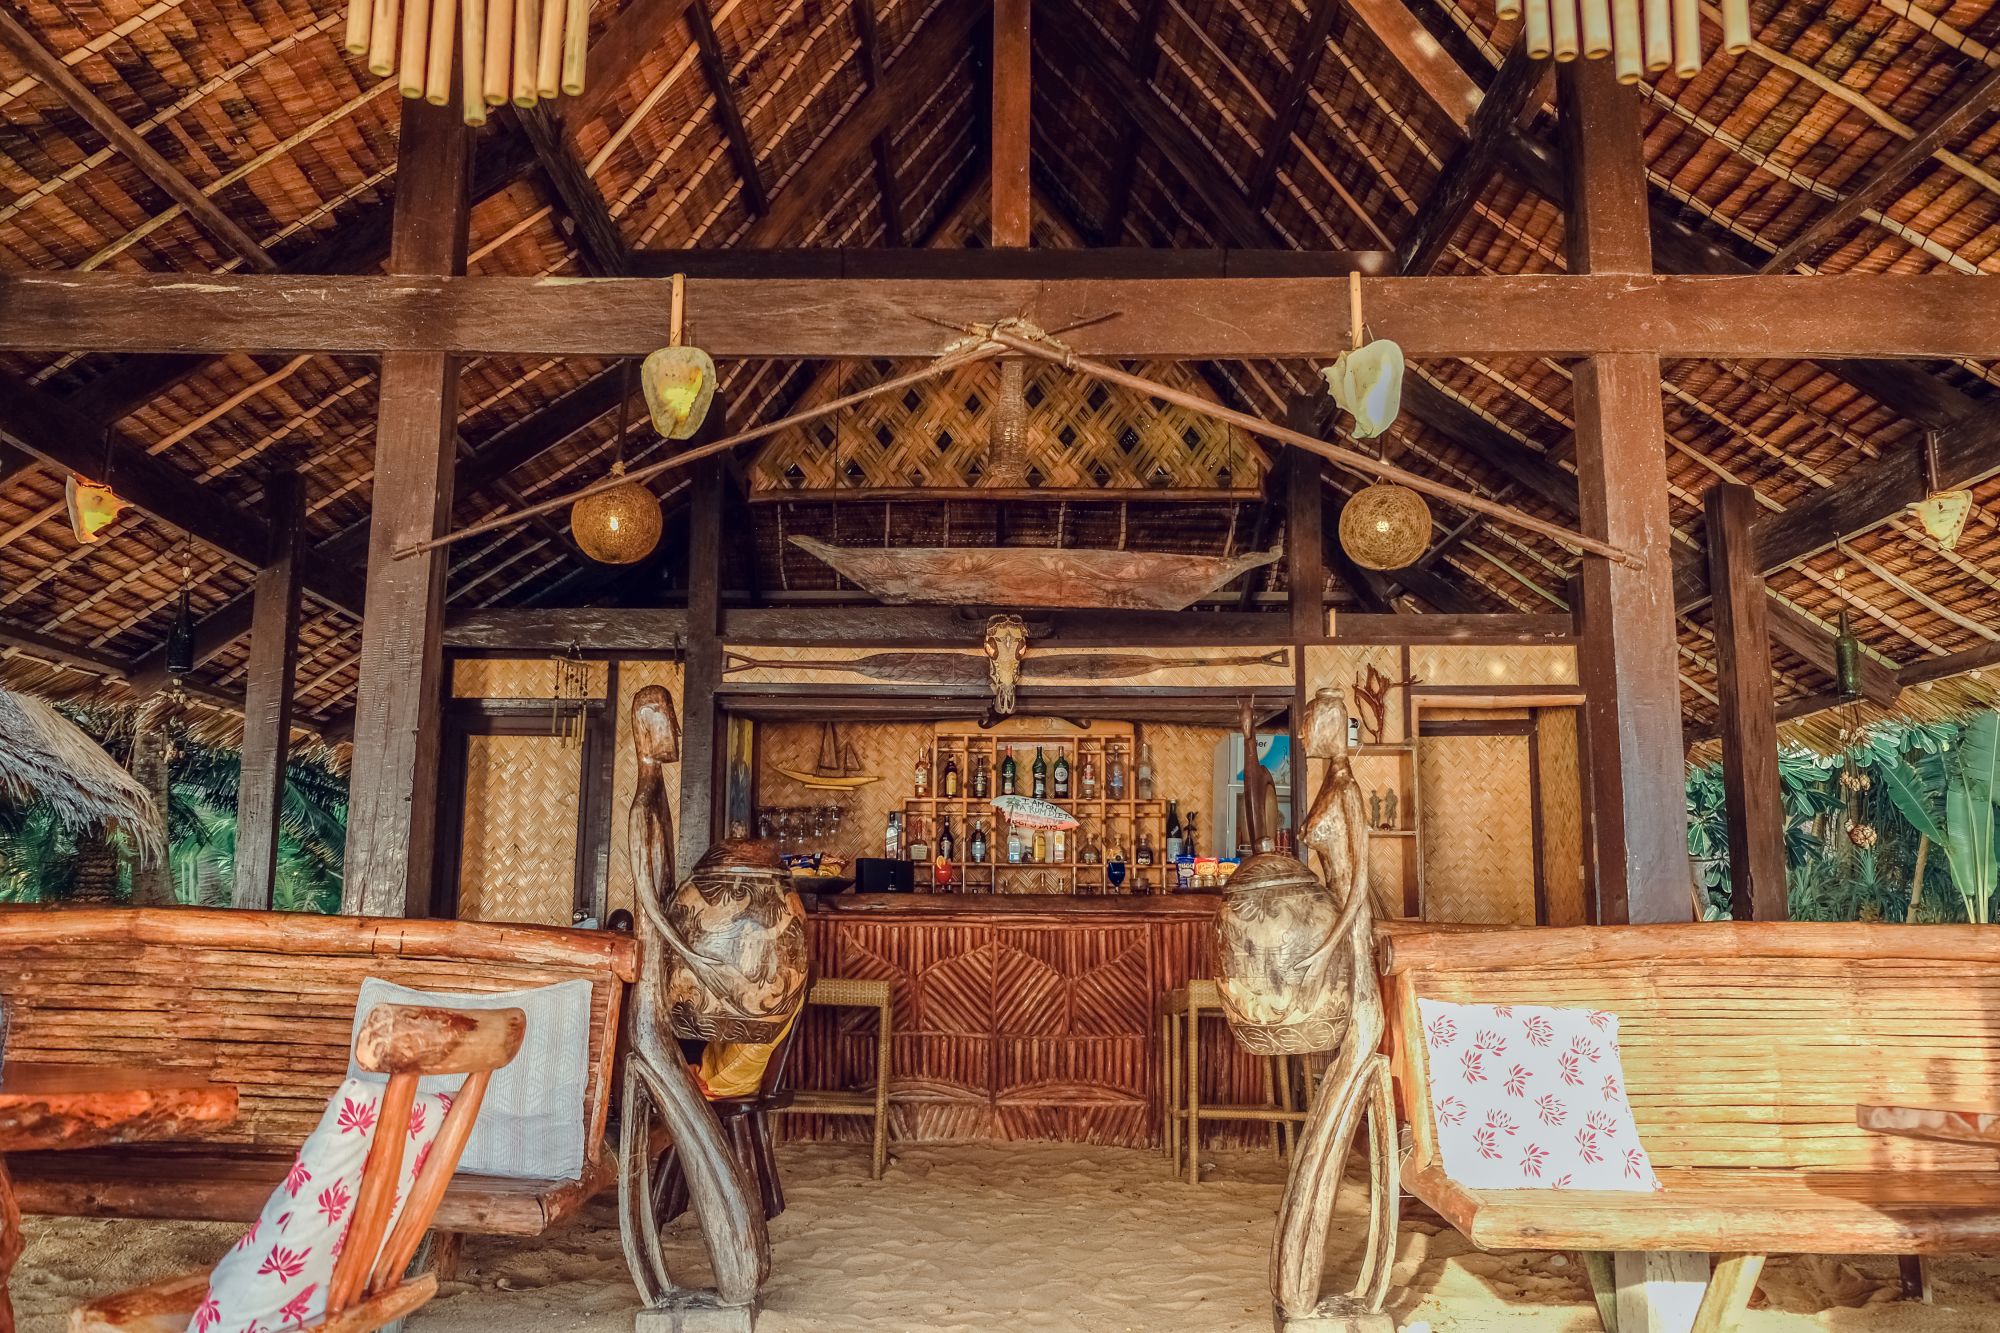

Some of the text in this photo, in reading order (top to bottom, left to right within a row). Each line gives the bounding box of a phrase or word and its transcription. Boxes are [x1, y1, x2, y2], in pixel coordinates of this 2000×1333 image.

[1028, 805, 1045, 816] RUM
[1032, 800, 1044, 809] AM
[1045, 804, 1058, 814] ON
